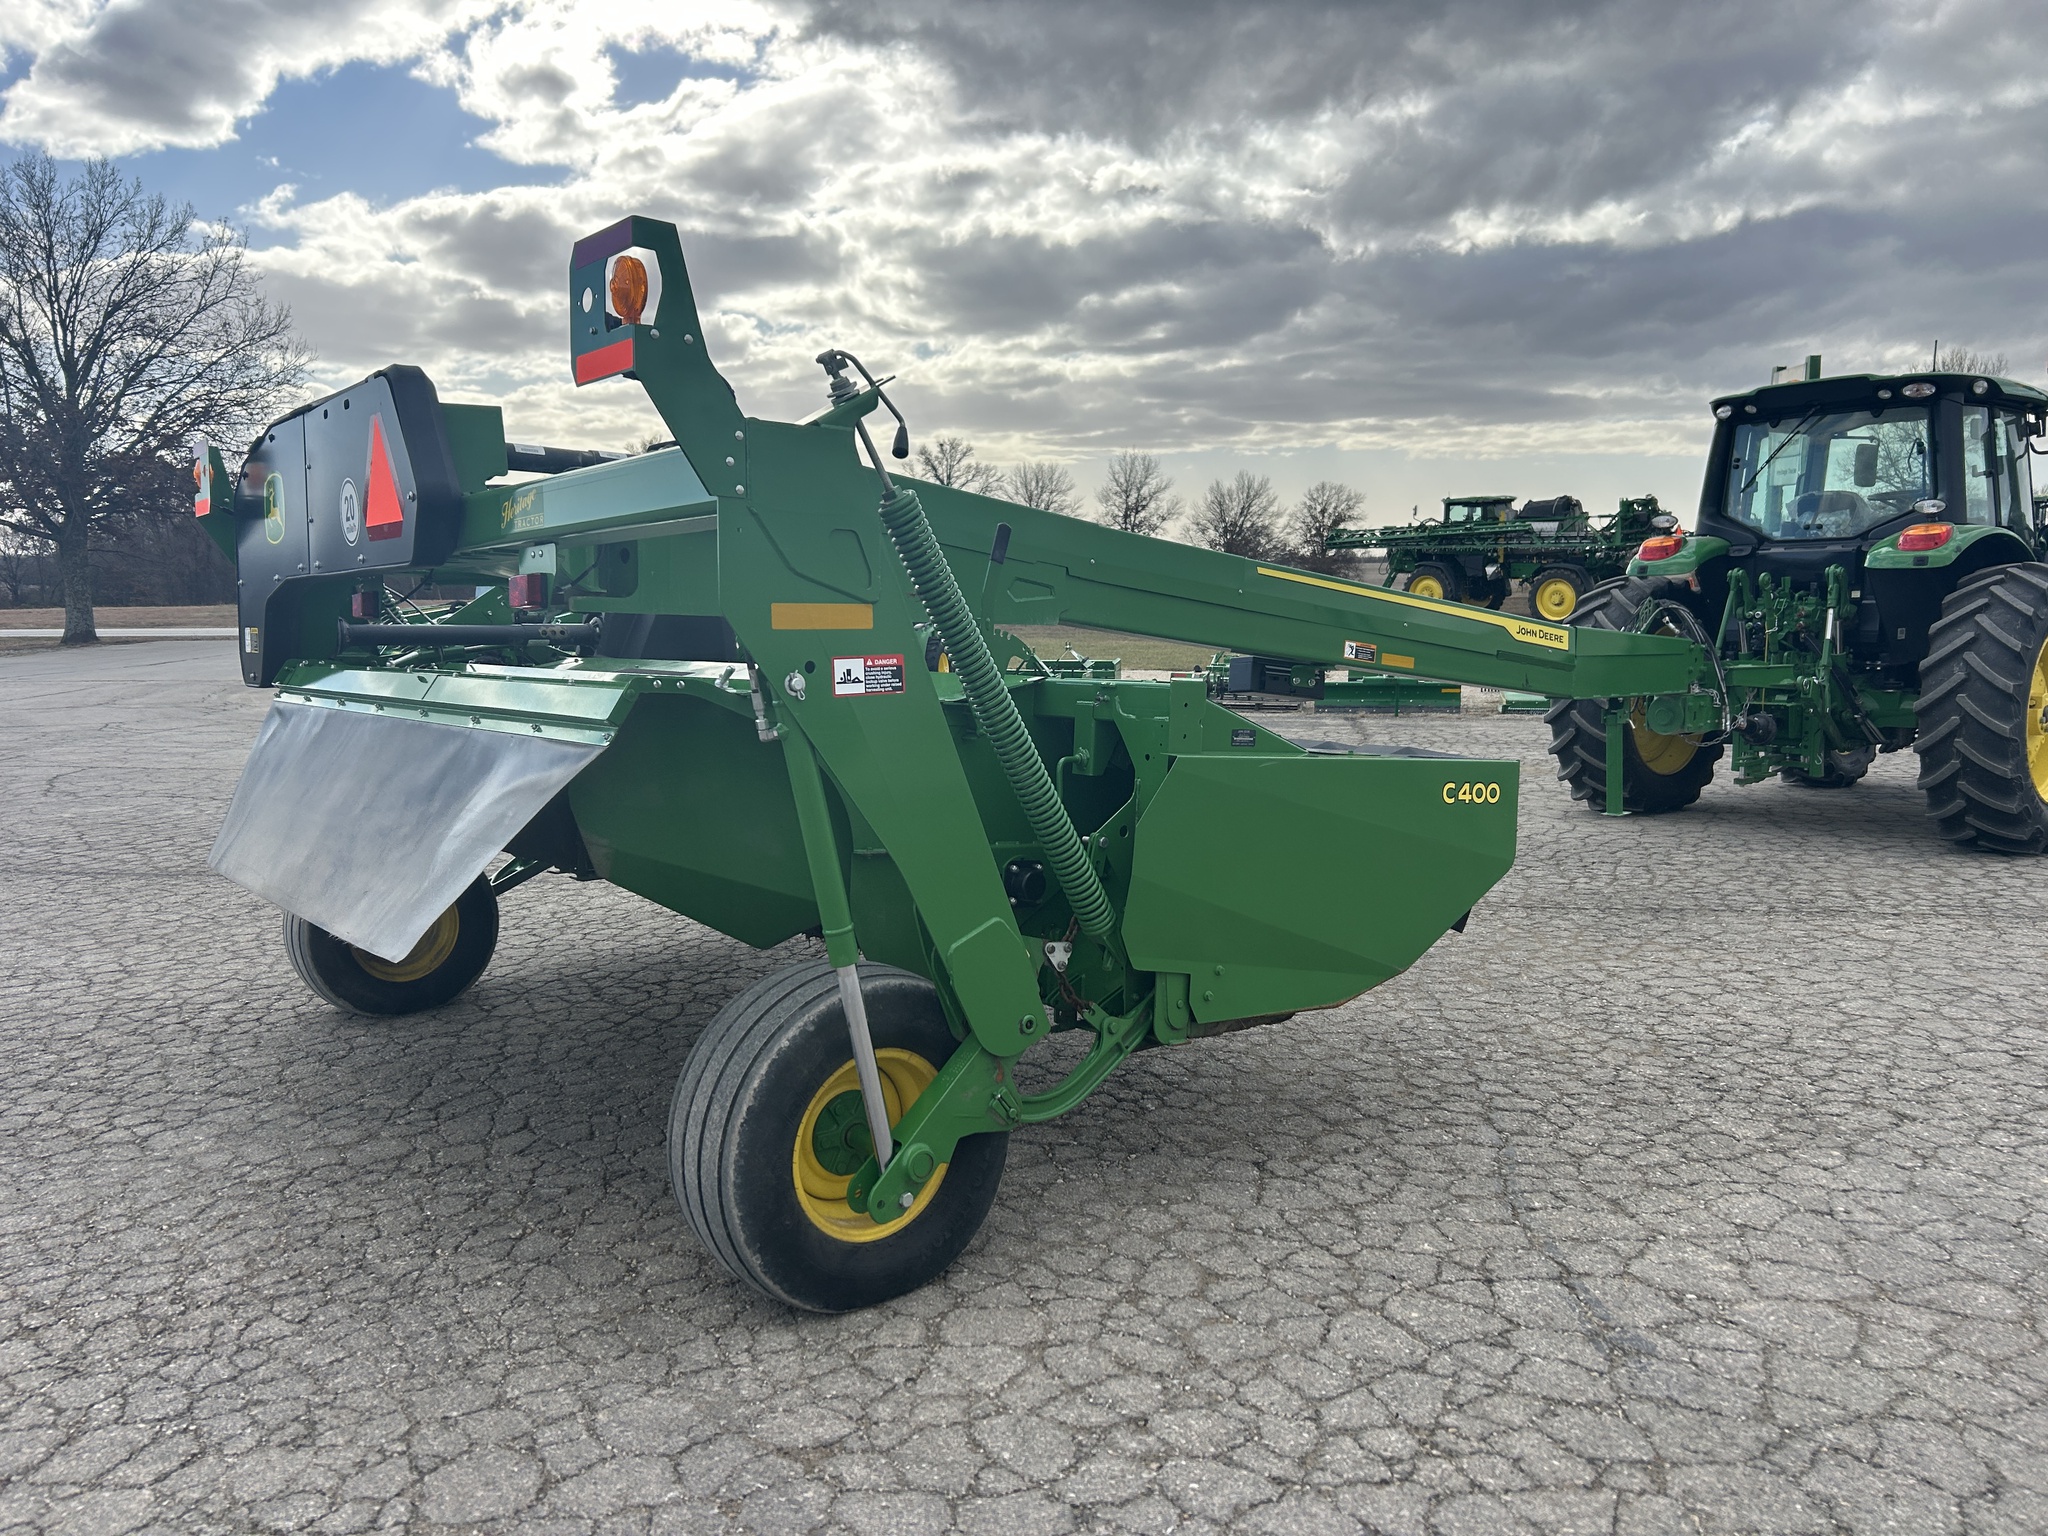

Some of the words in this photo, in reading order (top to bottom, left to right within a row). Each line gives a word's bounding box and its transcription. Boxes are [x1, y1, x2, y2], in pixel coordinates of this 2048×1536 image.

[344, 494, 354, 522] 20
[501, 488, 536, 529] Heritage
[514, 515, 544, 529] TRACTOR
[1516, 625, 1537, 638] JOHN
[1538, 629, 1564, 643] DEERE
[1442, 782, 1501, 804] C400
